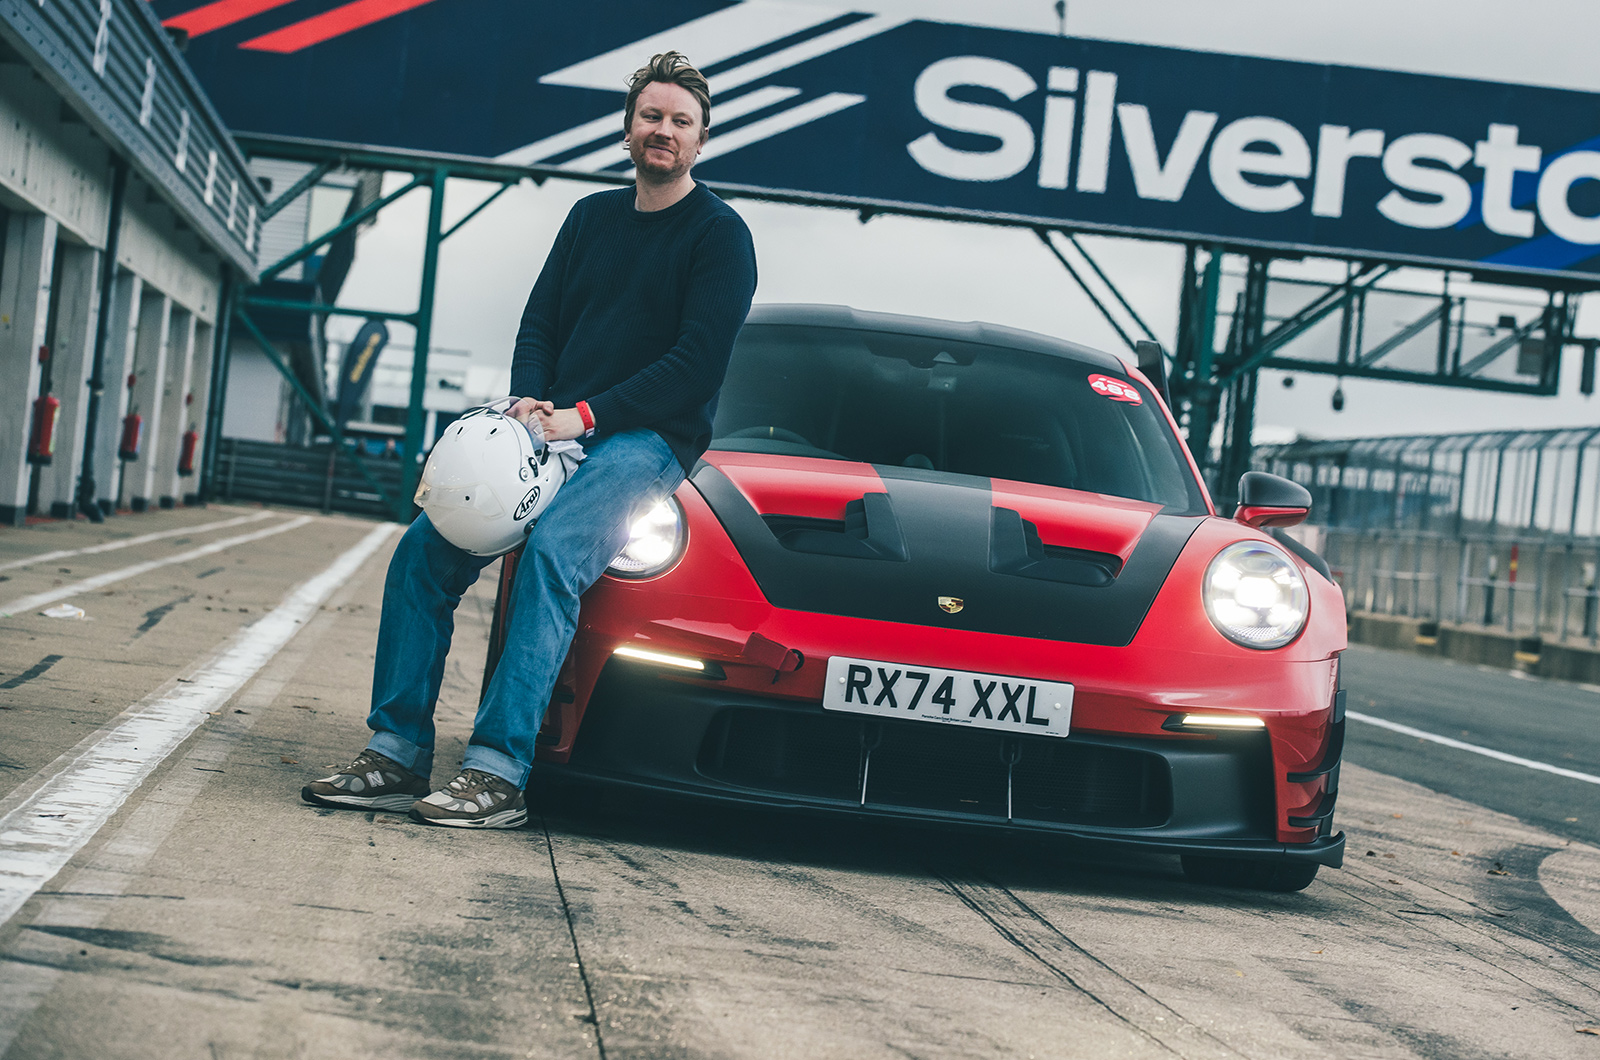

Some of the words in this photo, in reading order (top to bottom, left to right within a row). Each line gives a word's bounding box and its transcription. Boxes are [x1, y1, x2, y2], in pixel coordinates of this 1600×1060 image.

[906, 55, 1600, 245] Silversto
[518, 488, 538, 519] Arai
[844, 664, 956, 714] RX74
[969, 678, 1049, 726] XXL
[366, 771, 385, 788] N
[475, 791, 495, 809] N
